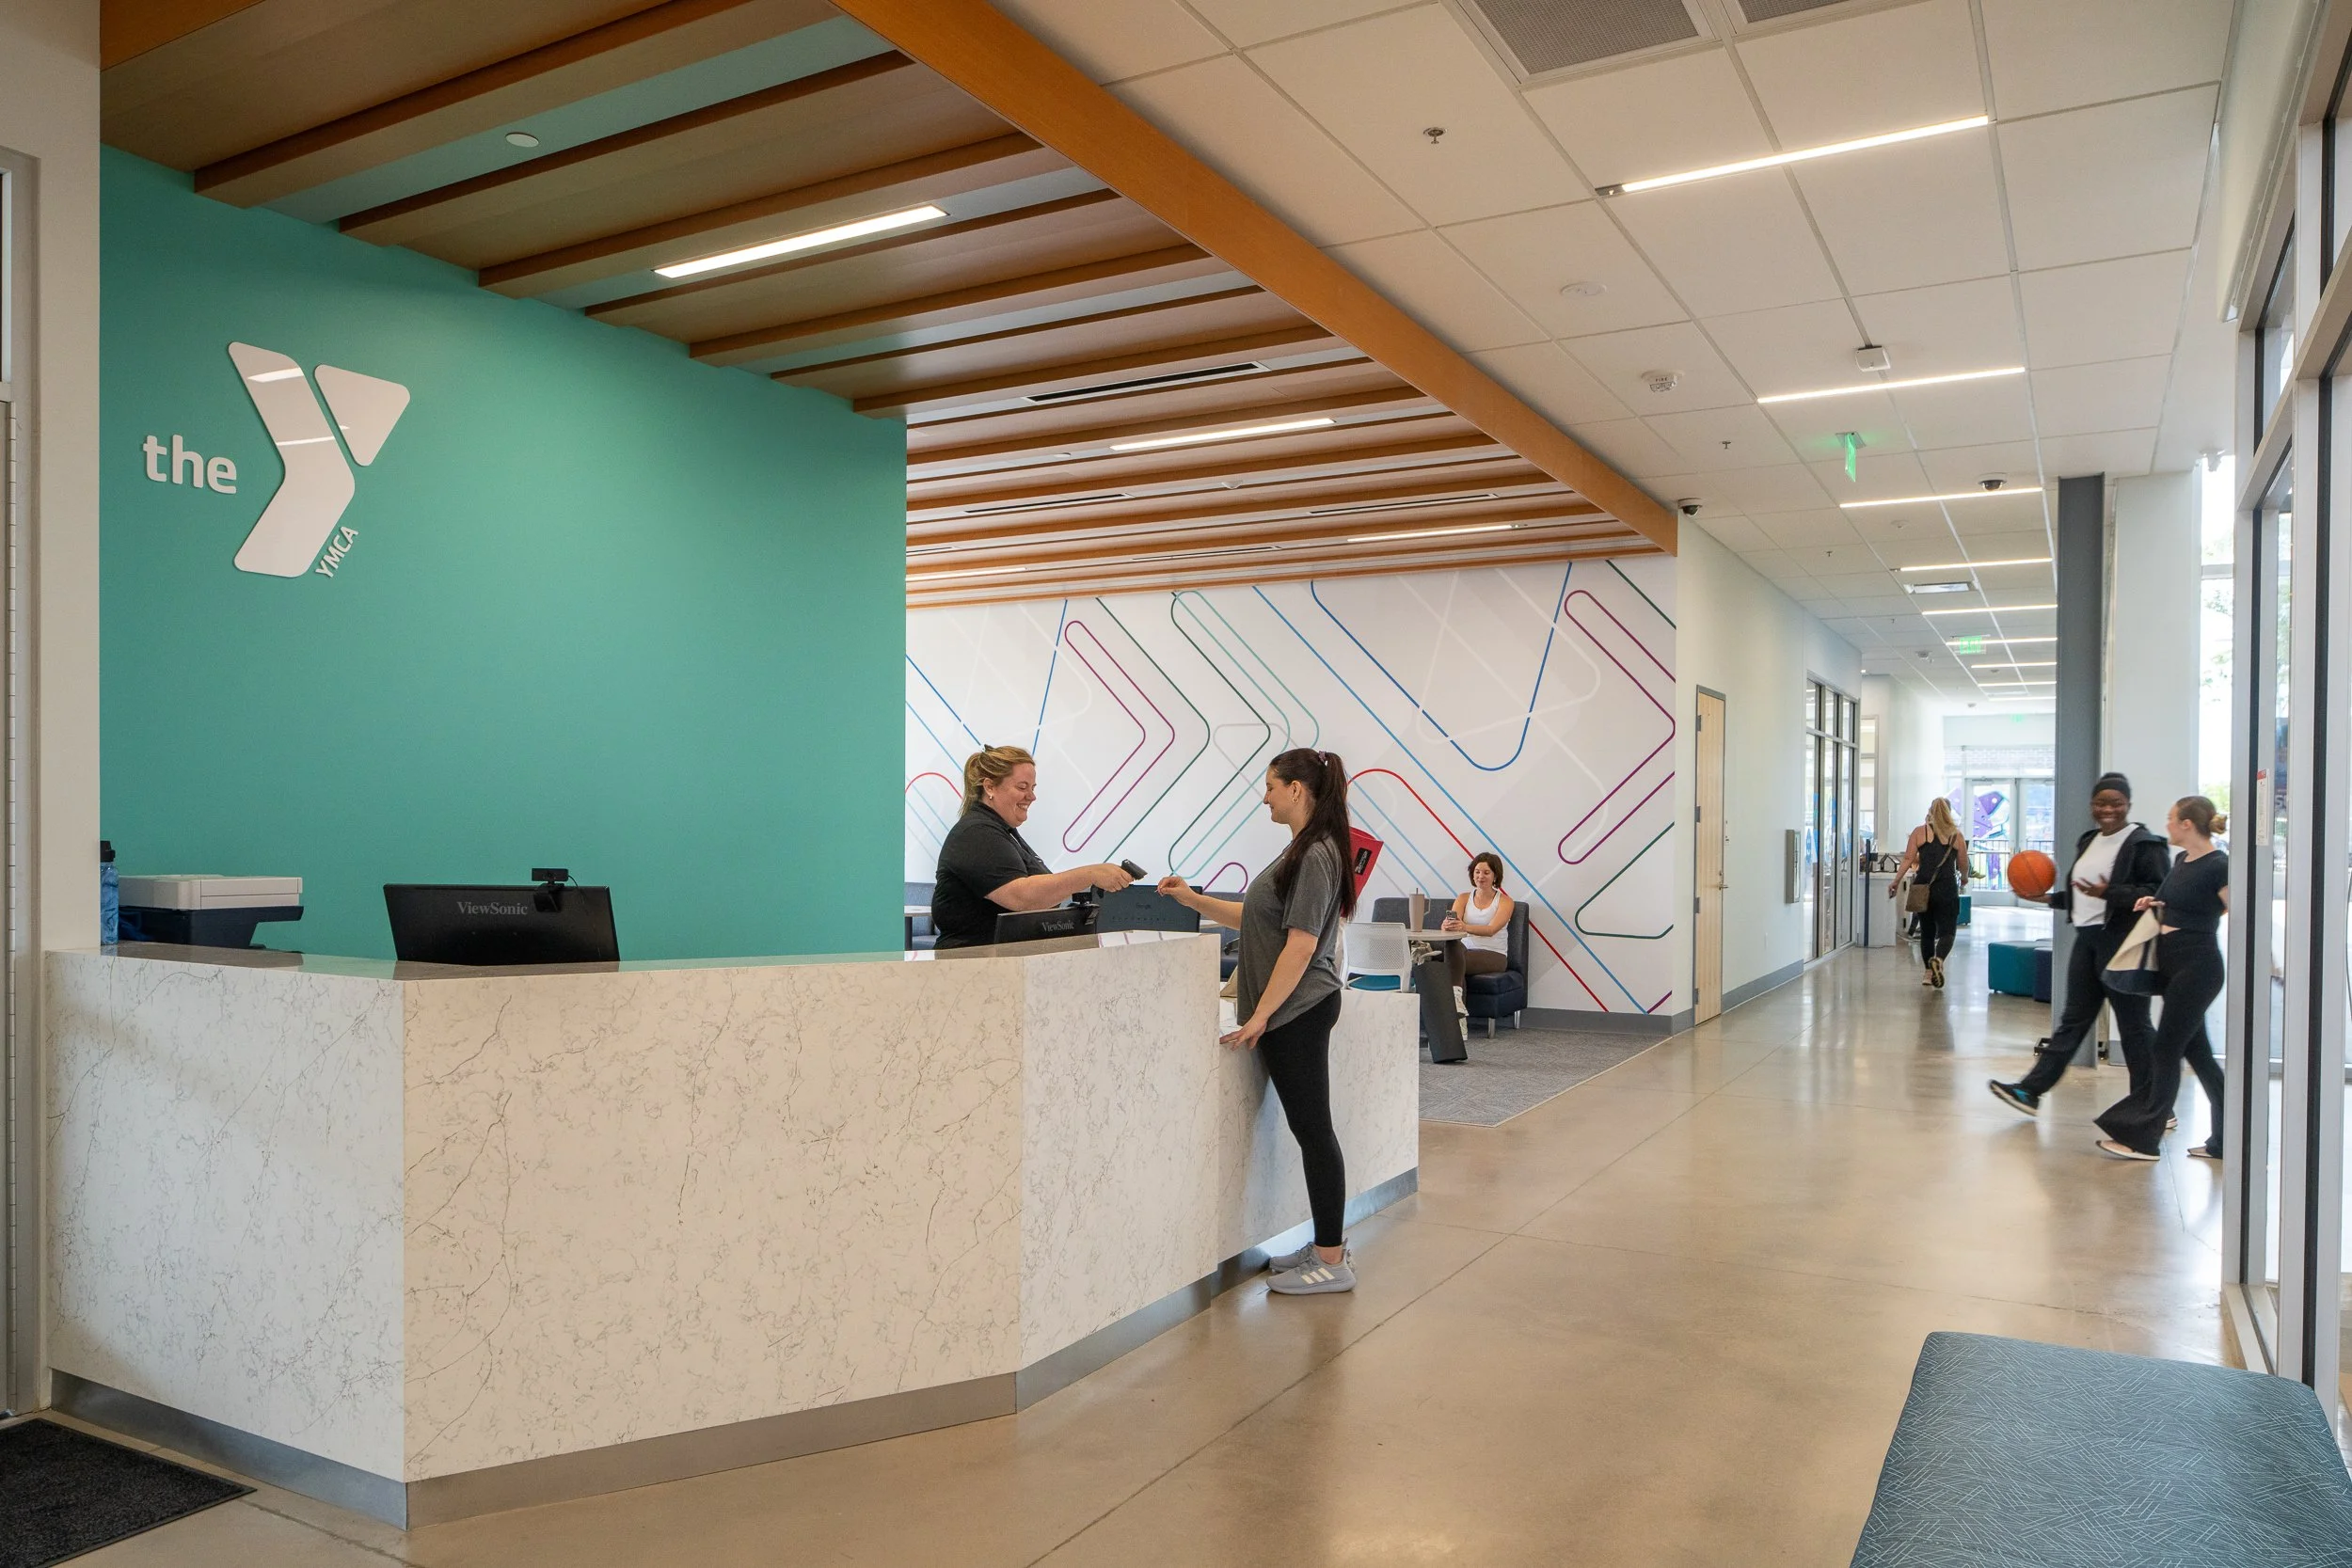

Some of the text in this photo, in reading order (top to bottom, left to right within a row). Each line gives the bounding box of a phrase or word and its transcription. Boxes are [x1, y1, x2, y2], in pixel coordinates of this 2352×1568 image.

[143, 435, 237, 495] the
[315, 526, 358, 578] YMCA
[456, 901, 528, 915] ViewSonic
[1041, 919, 1074, 932] ViewSonic
